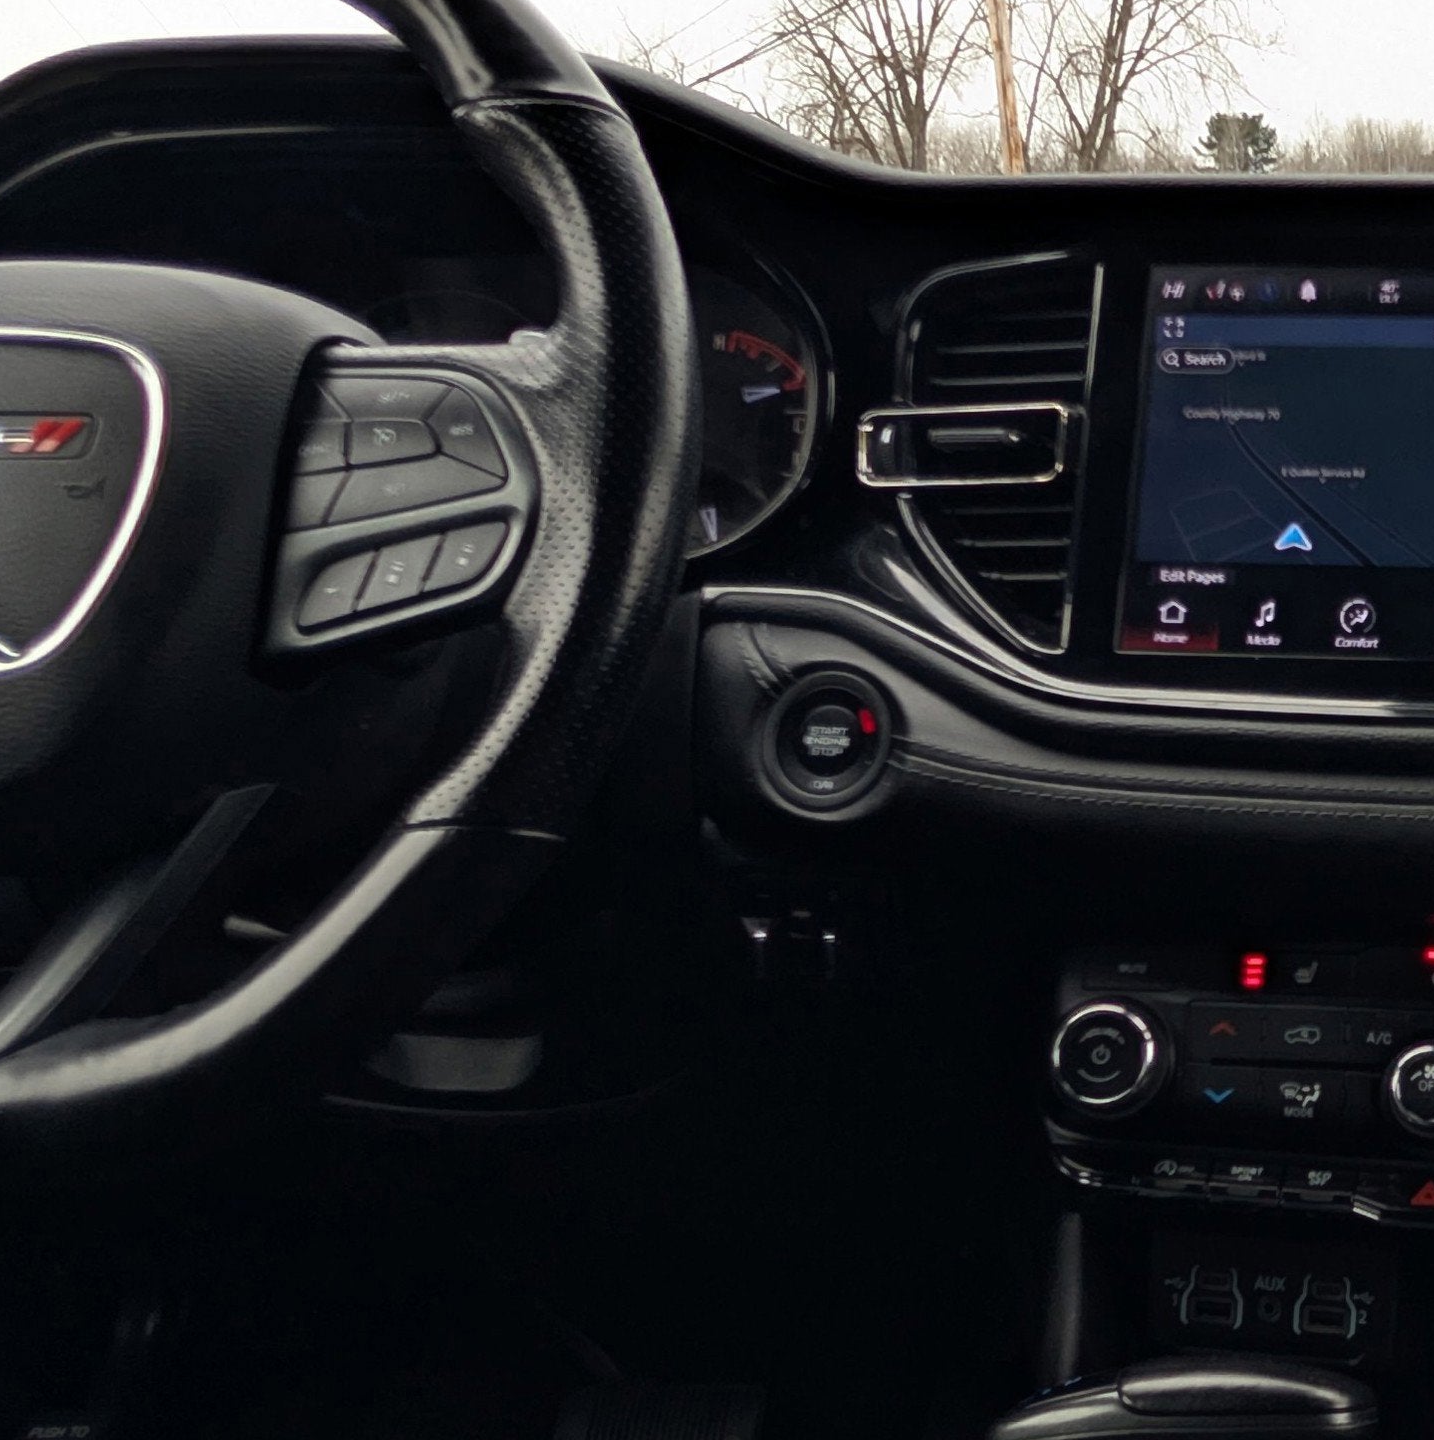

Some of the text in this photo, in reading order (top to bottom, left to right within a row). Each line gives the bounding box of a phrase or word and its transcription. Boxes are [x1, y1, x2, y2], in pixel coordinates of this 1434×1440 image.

[1184, 351, 1227, 366] Search
[1160, 570, 1226, 585] Edit Pages
[1246, 634, 1281, 647] Media
[1335, 637, 1380, 650] Comfort
[807, 725, 850, 736] START
[804, 735, 851, 747] ENGINE
[1366, 1030, 1392, 1046] A/C
[1254, 1275, 1287, 1292] AUX
[27, 1424, 90, 1439] PUSH TO
